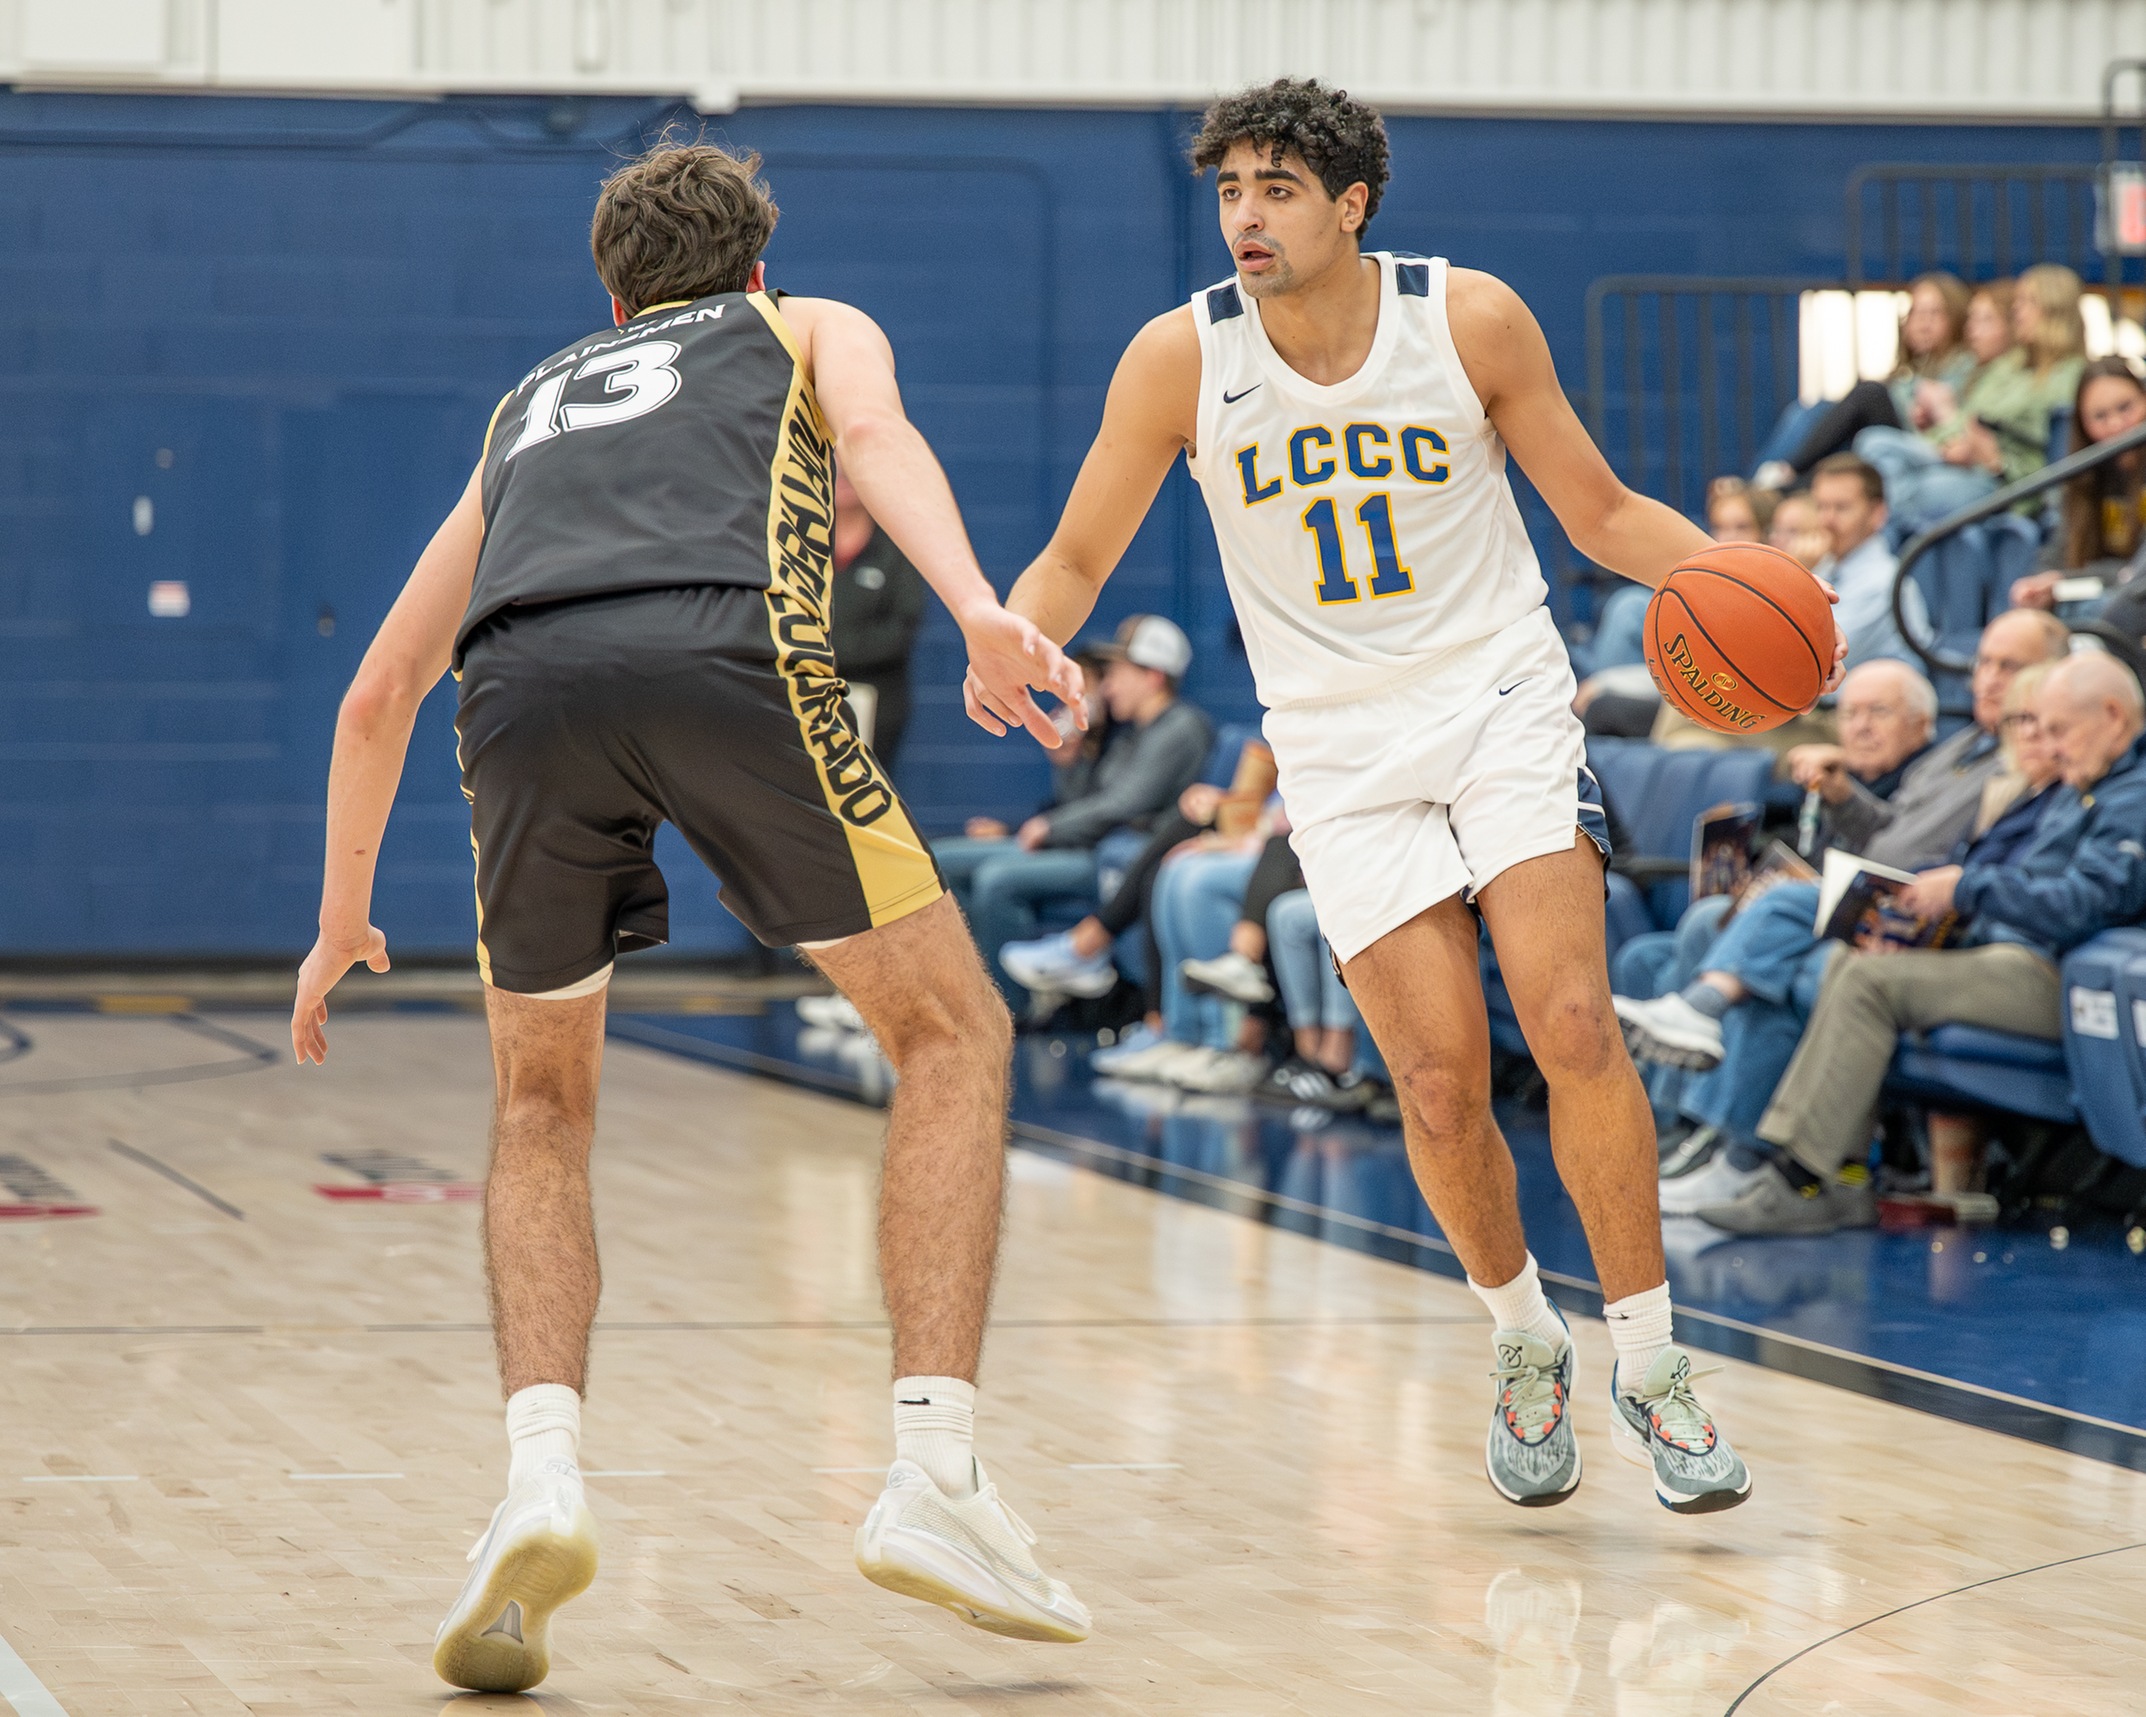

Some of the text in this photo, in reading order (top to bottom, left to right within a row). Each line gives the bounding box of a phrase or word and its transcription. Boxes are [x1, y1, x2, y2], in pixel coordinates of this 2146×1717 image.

[504, 340, 682, 462] 13
[1235, 421, 1451, 508] LCCC
[1300, 491, 1416, 606] 11
[1664, 632, 1767, 729] SPALDING
